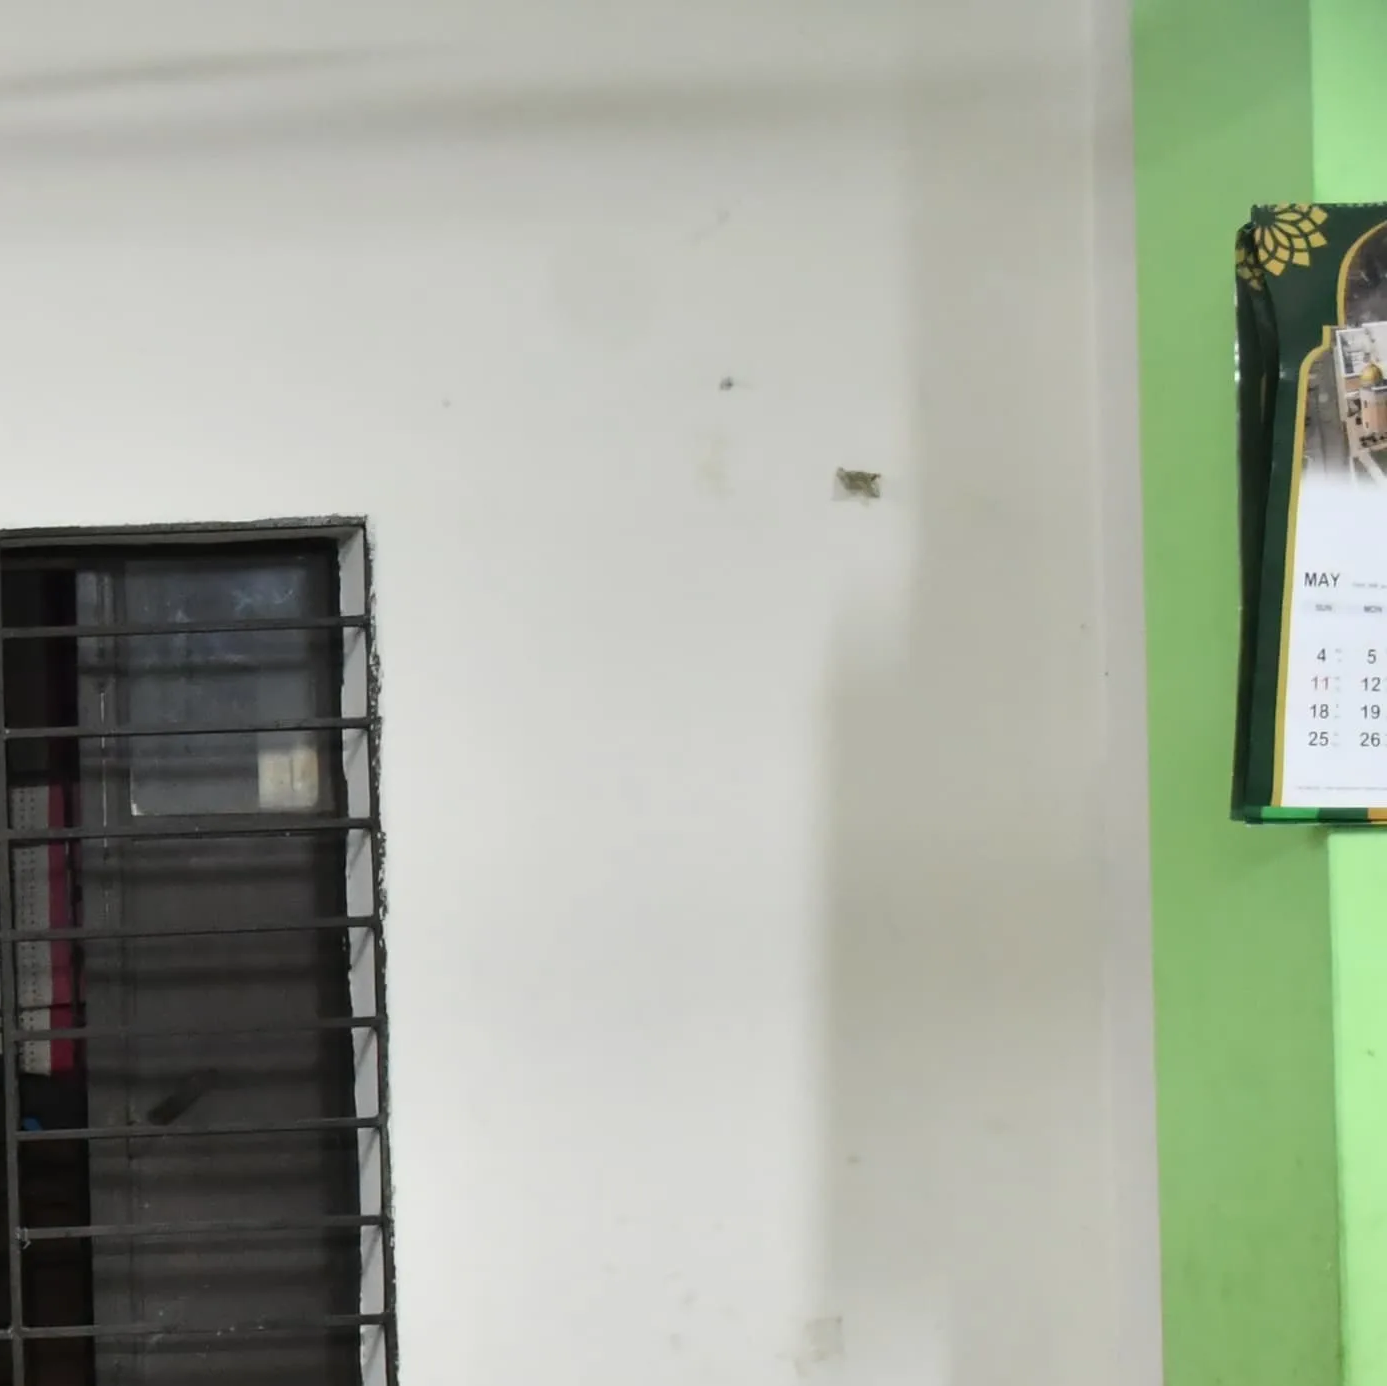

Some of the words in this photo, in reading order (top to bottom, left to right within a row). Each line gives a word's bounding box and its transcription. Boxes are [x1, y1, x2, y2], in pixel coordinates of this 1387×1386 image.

[1304, 572, 1340, 588] MAY
[1316, 648, 1327, 663] 4
[1367, 649, 1377, 664] 5
[1310, 675, 1330, 691] 11
[1361, 677, 1381, 692] 12
[1310, 704, 1330, 719] 18
[1360, 705, 1381, 719] 19
[1308, 731, 1329, 747] 25
[1359, 732, 1381, 747] 26
